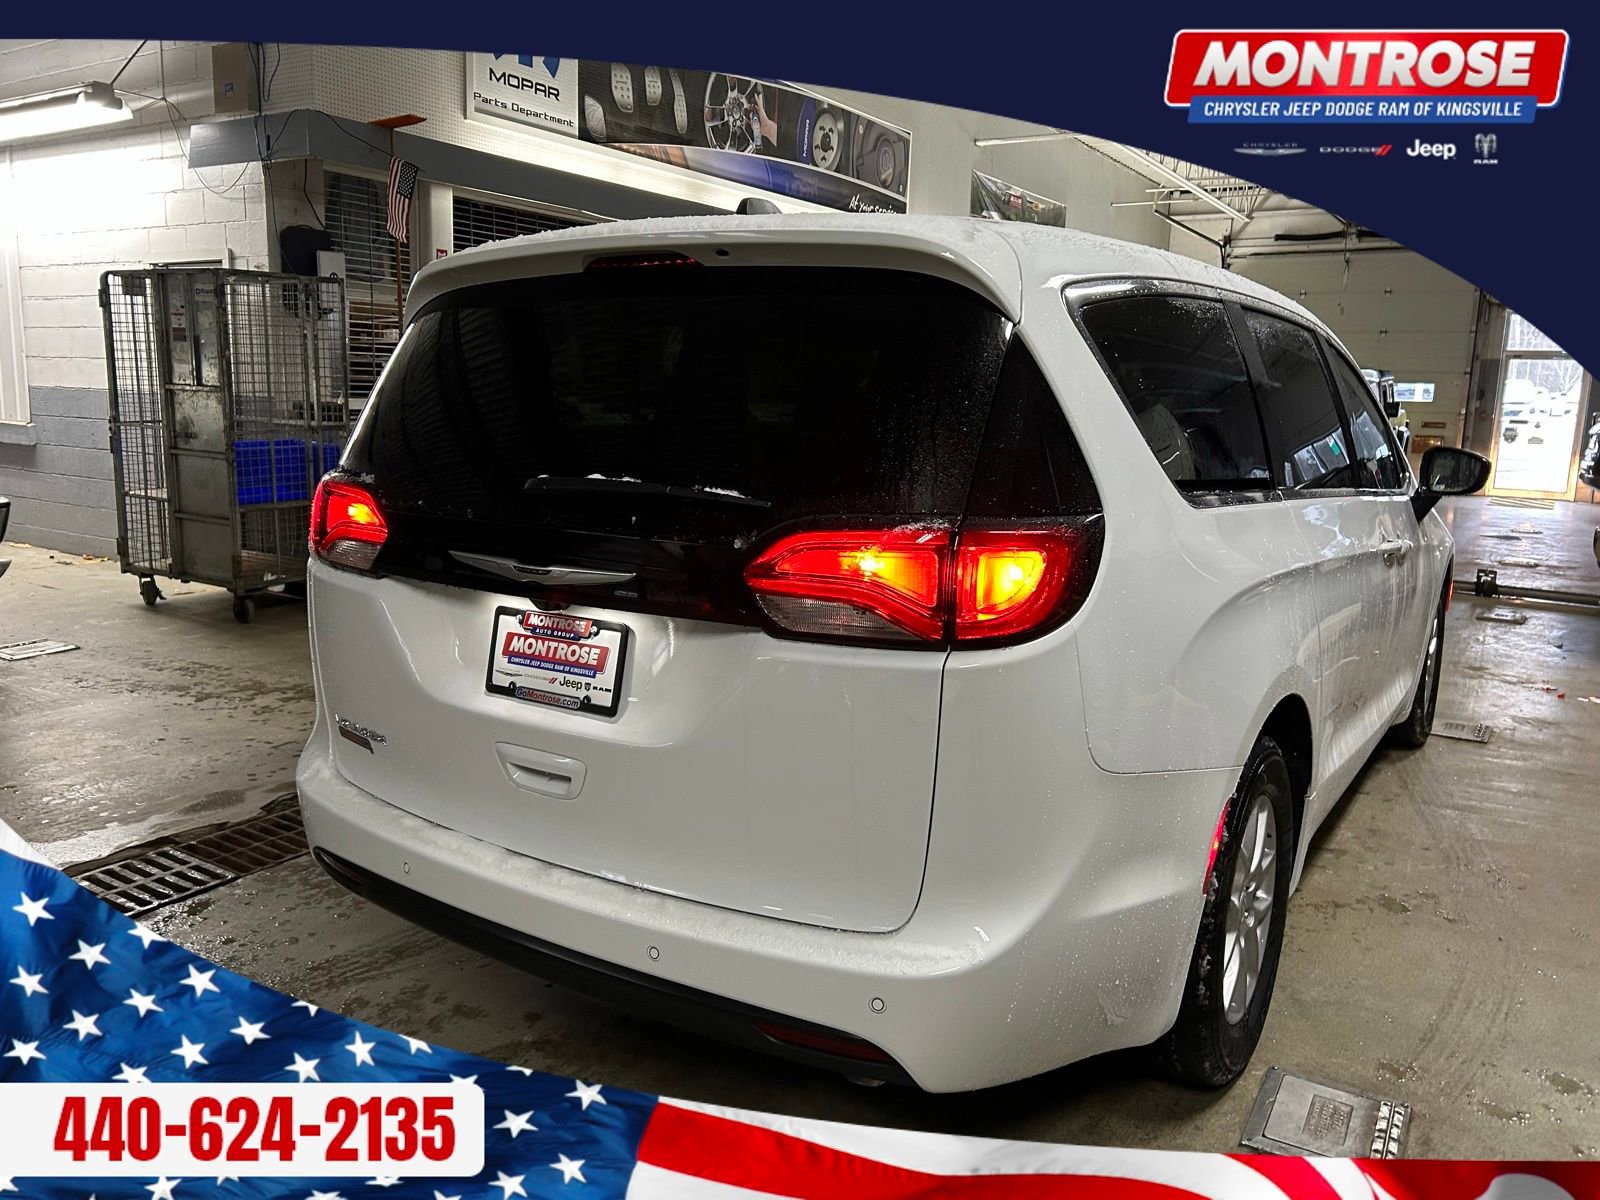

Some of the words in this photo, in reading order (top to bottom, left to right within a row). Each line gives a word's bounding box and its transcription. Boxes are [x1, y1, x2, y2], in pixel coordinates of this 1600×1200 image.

[489, 67, 560, 101] MOPAR
[473, 92, 507, 109] Parts
[511, 103, 574, 127] Department
[849, 194, 860, 210] At
[528, 614, 587, 633] MONTROSE
[553, 631, 575, 639] GROUP
[509, 636, 600, 665] MONTROSE
[510, 656, 530, 665] CHRYSLER
[530, 659, 540, 667] JEEP
[540, 661, 554, 670] DODGE
[555, 663, 564, 671] RAM
[559, 676, 583, 691] Jeep
[516, 687, 579, 708] GoMontrose.com
